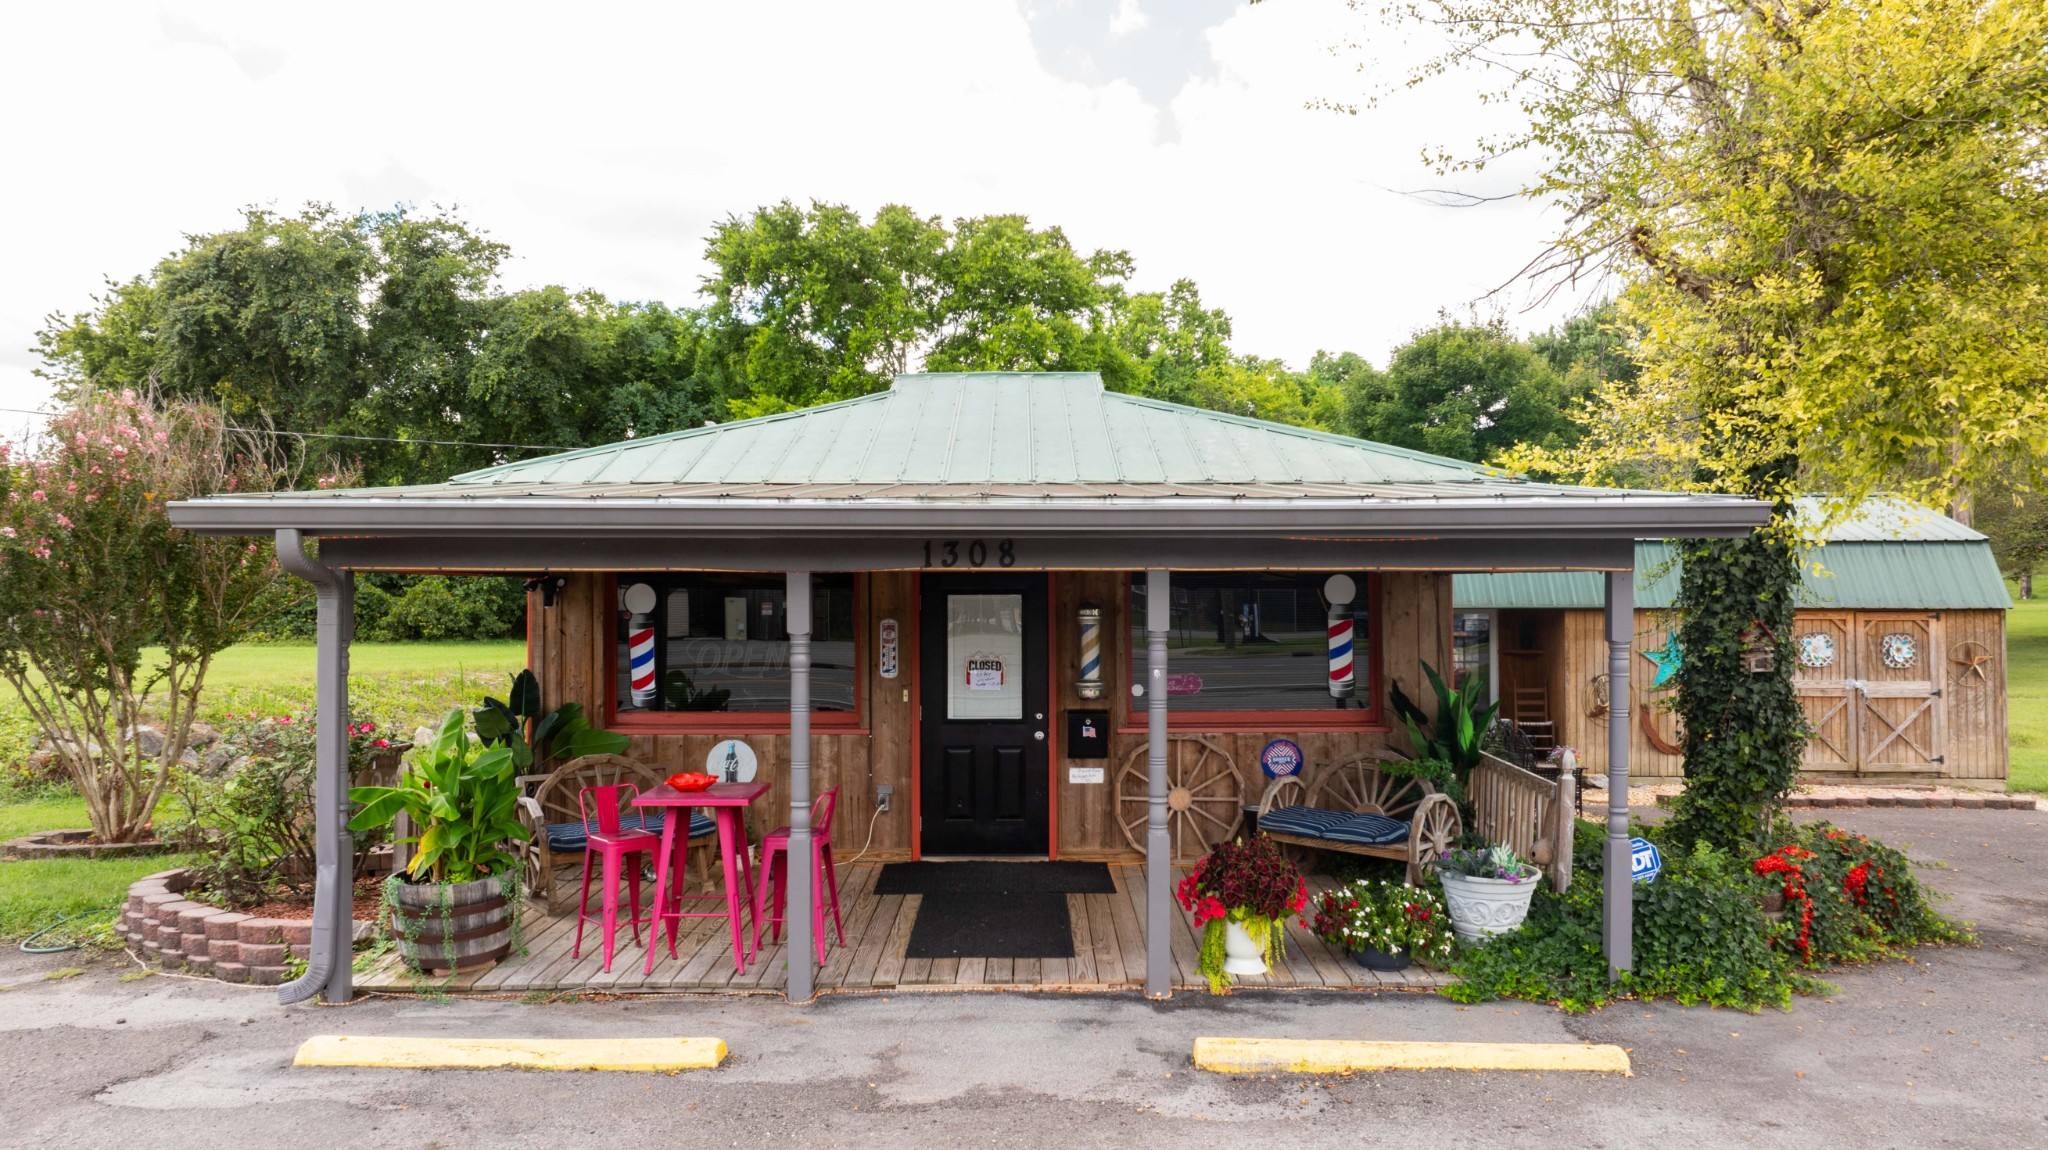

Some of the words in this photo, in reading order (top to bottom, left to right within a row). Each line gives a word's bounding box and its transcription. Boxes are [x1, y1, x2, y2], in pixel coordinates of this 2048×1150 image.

[923, 539, 1016, 568] 1308
[696, 641, 789, 675] OPEN
[968, 660, 1002, 671] CLOSED
